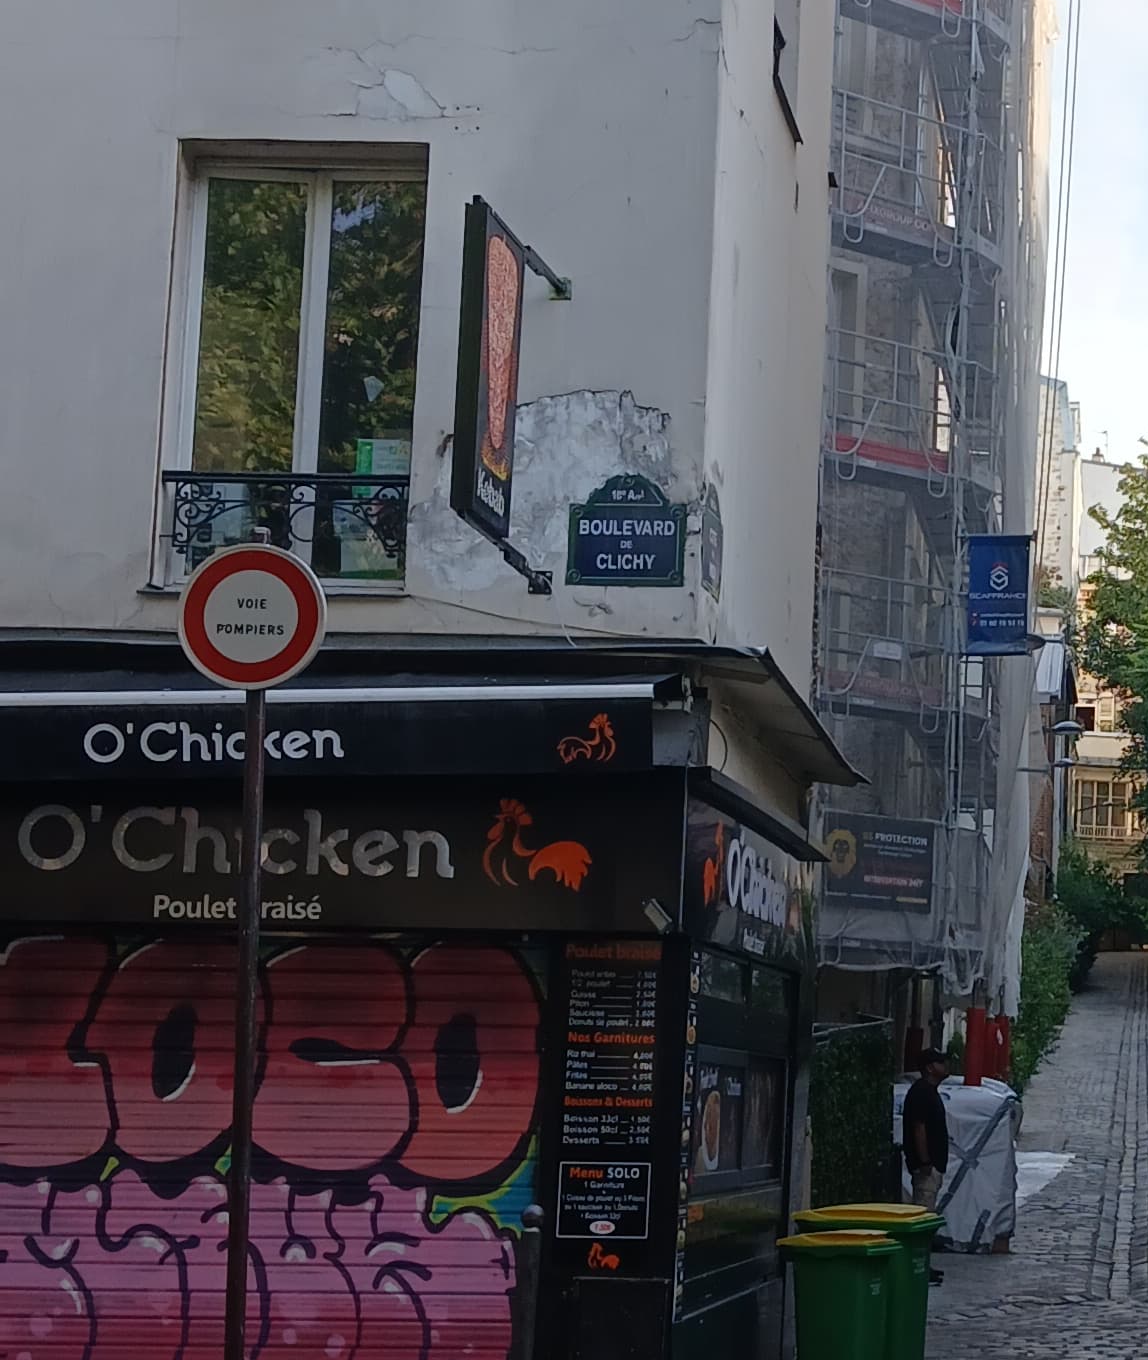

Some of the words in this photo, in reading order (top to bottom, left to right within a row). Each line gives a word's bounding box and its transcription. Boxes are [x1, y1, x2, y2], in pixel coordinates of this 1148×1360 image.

[476, 467, 505, 517] Kebab
[578, 519, 676, 536] BOULEVARD
[619, 539, 634, 549] DE
[596, 553, 657, 570] CLICHY
[237, 598, 267, 609] VOIE
[216, 623, 284, 636] POMPIERS
[153, 894, 237, 920] Poulet
[258, 894, 322, 920] raisé
[567, 1031, 590, 1043] Nos
[593, 1031, 656, 1044] Garnitures
[615, 1096, 653, 1108] Desserts
[563, 1114, 599, 1123] Boisson
[563, 1124, 599, 1134] Boisson
[569, 1167, 604, 1179] Menu
[606, 1167, 640, 1179] SOLO
